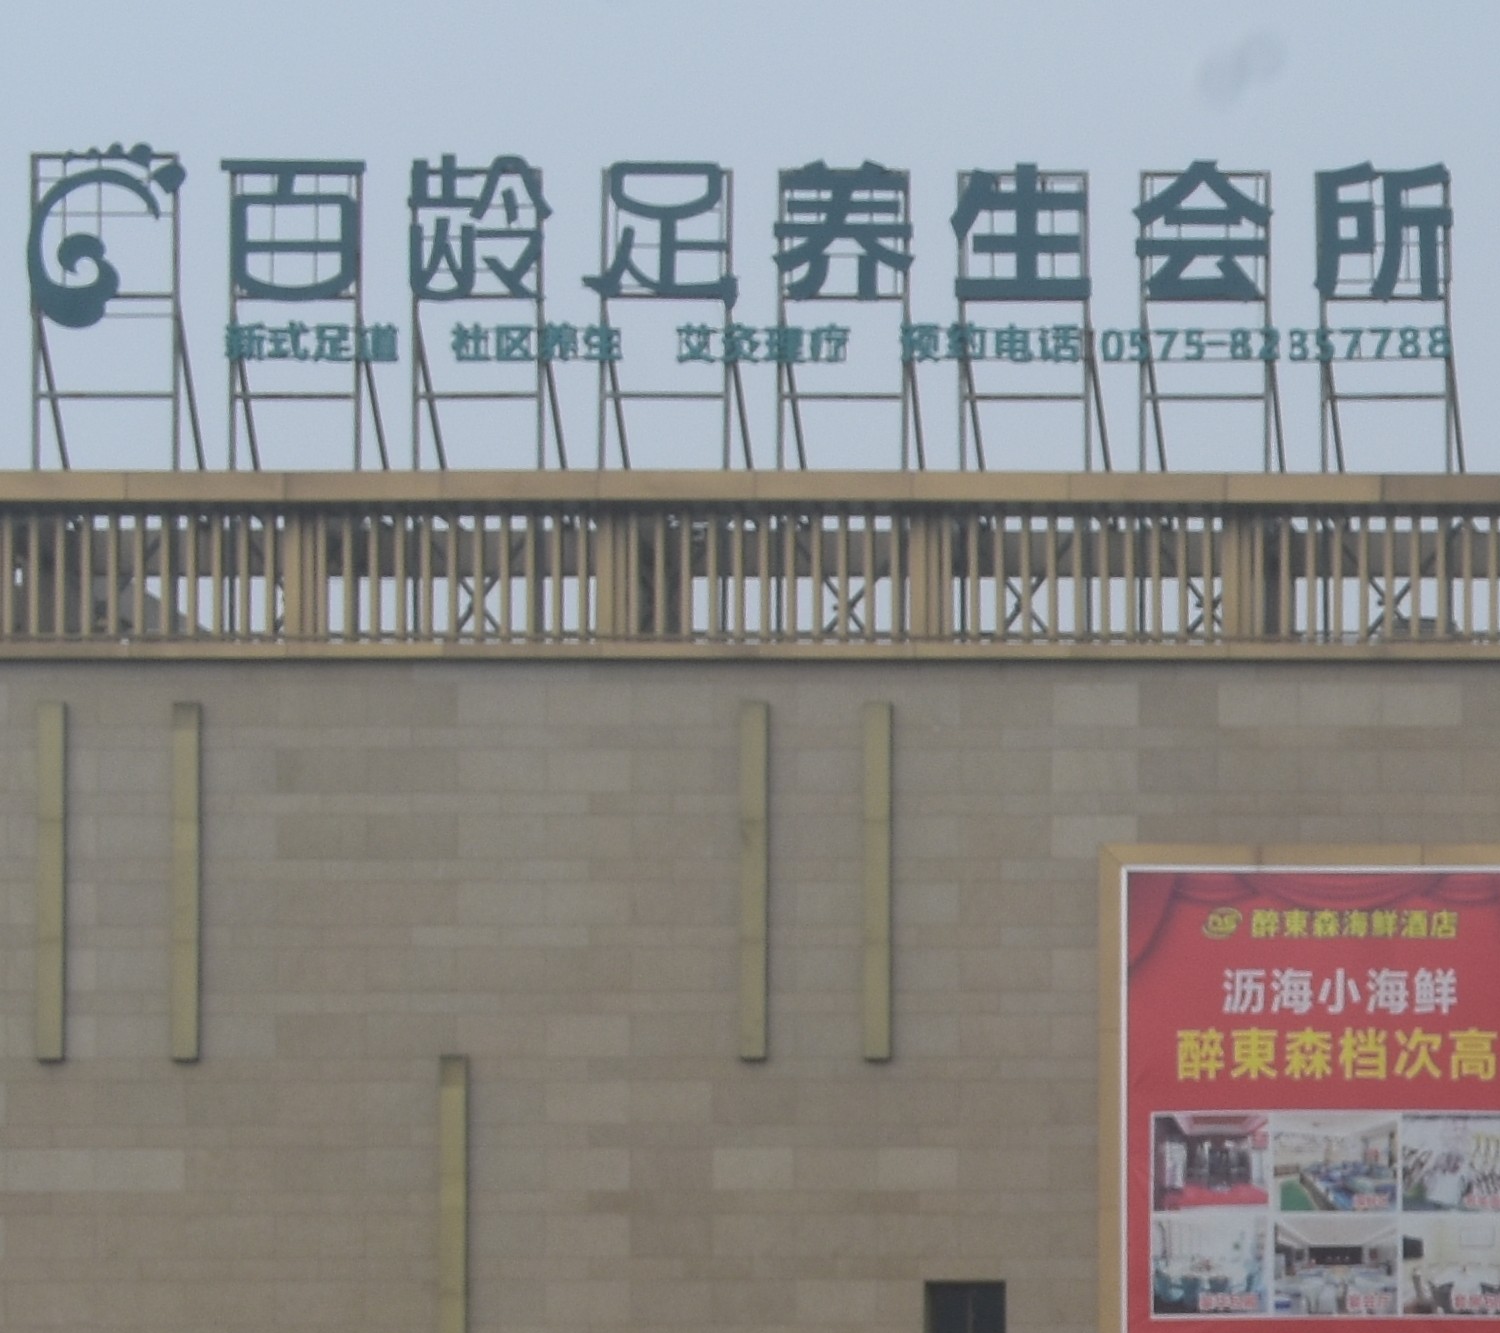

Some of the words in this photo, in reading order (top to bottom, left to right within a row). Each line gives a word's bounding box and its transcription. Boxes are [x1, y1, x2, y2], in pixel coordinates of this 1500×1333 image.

[221, 154, 1453, 308] 百龄足养生会所
[900, 322, 1081, 363] 预约电话
[1222, 967, 1458, 1015] 沥海小海鲜
